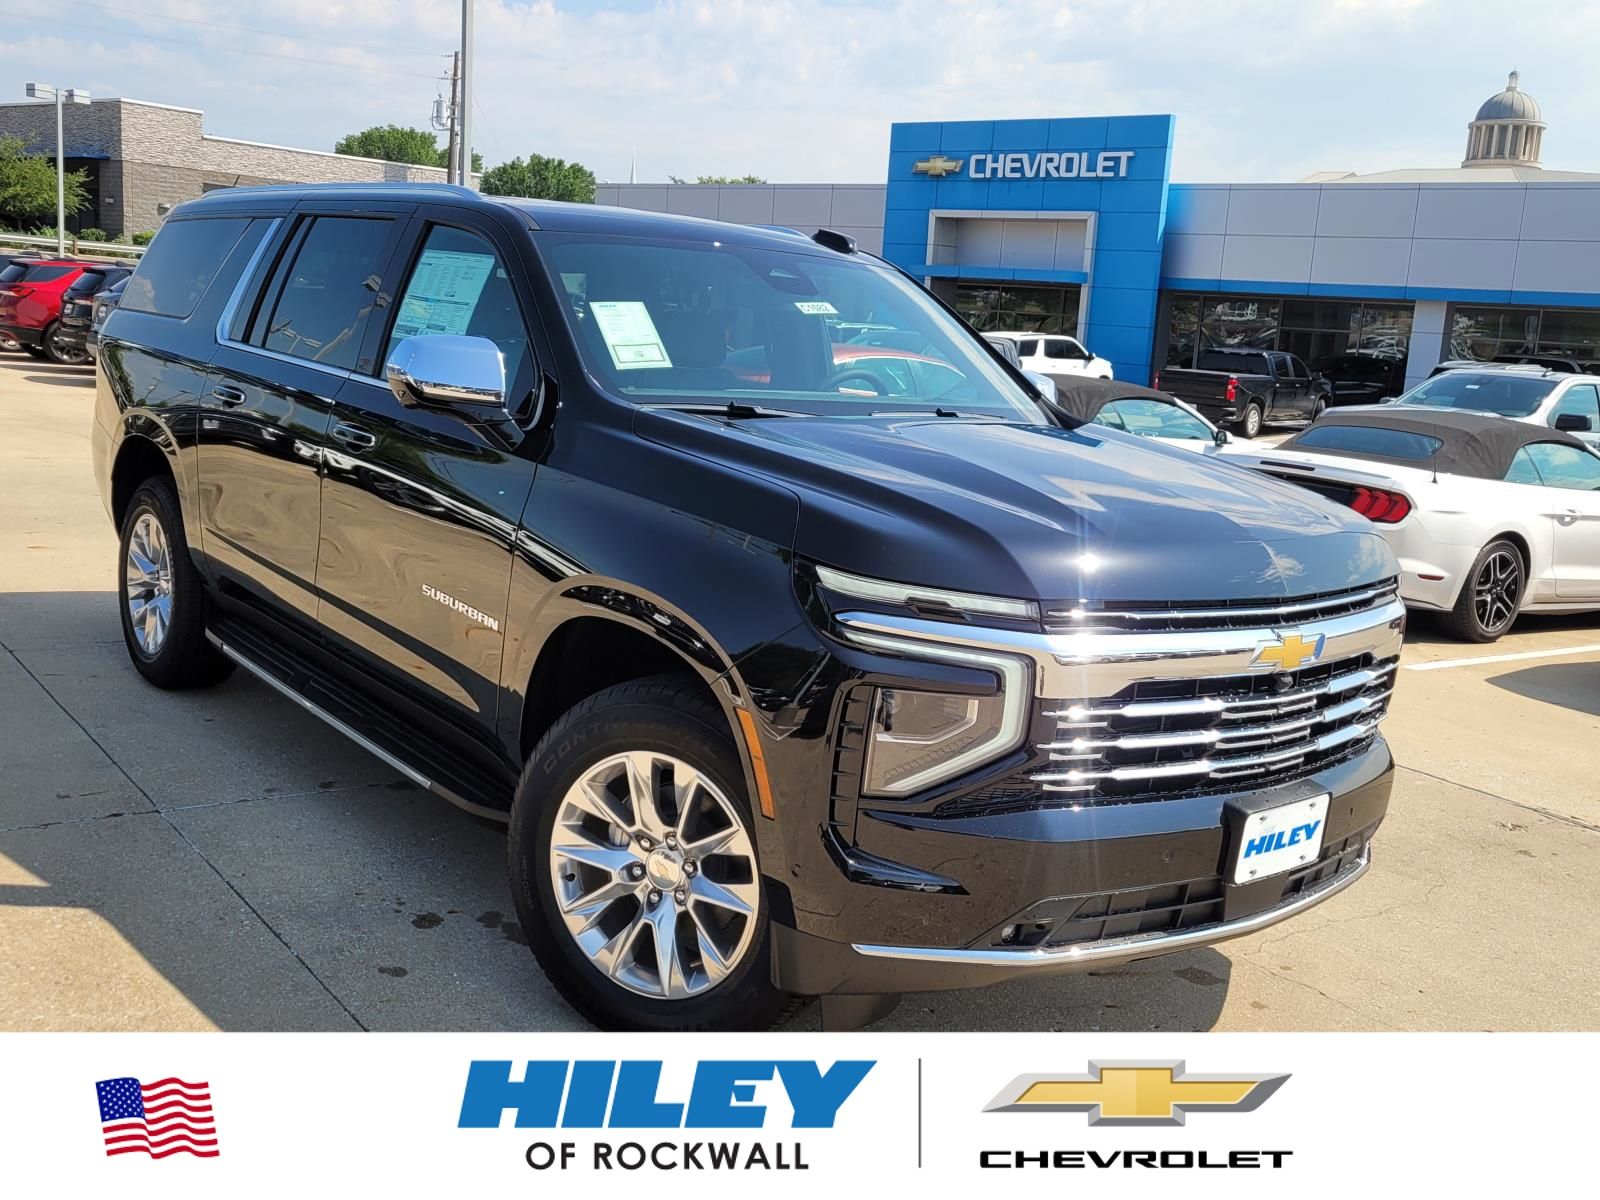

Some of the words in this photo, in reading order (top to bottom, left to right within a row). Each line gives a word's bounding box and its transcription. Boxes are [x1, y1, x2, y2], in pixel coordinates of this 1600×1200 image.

[968, 151, 1135, 179] CHEVROLET
[421, 583, 499, 631] SUBURBAN
[1243, 819, 1321, 858] HILEY
